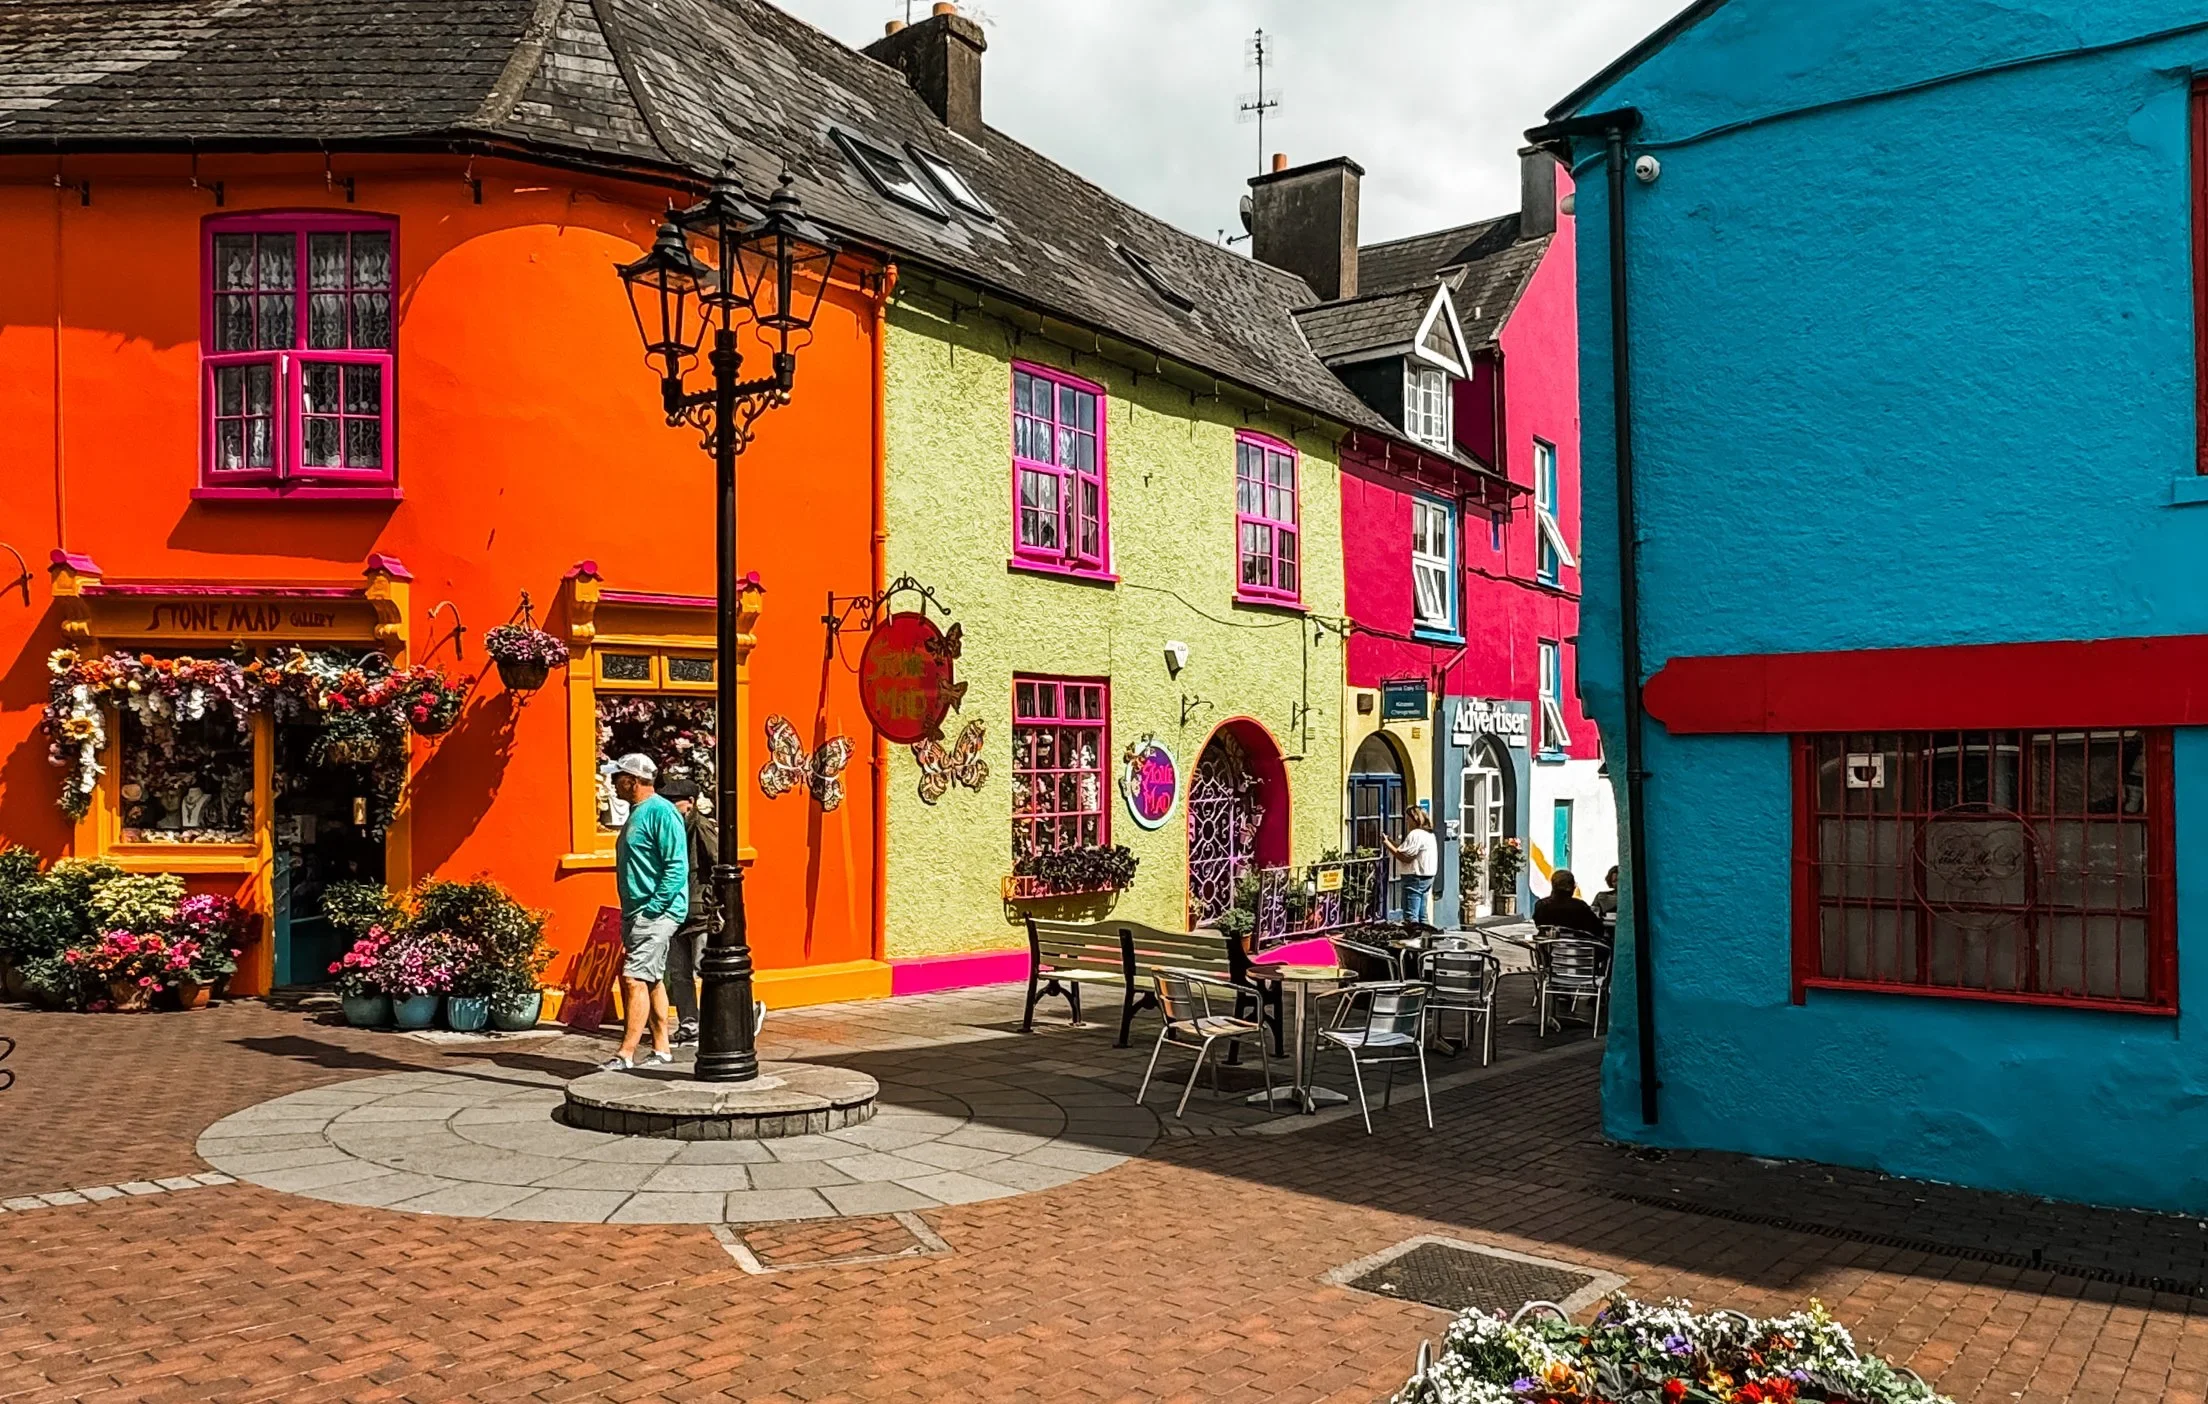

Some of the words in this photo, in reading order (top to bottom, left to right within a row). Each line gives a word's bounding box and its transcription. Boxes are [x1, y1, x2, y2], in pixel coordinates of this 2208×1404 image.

[145, 603, 222, 631] STONE
[226, 603, 281, 632] MAD
[1453, 701, 1528, 733] Advertiser
